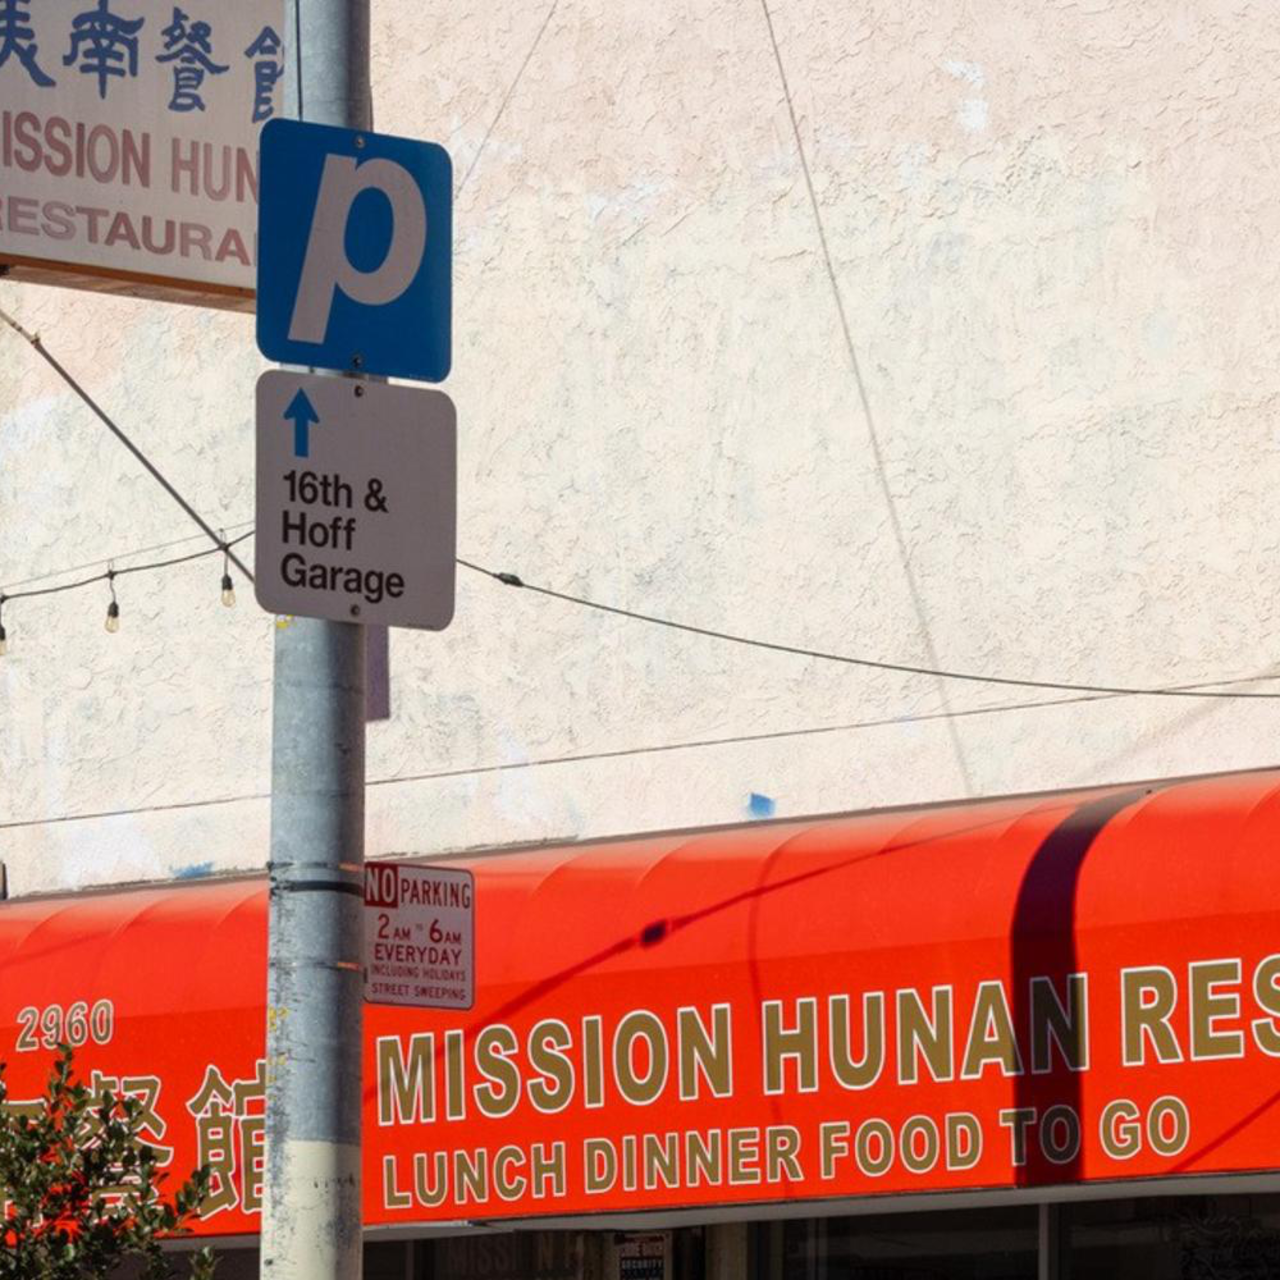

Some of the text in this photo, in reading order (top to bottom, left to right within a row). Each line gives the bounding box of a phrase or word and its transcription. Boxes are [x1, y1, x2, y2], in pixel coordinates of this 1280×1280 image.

[282, 471, 388, 513] 16th &
[281, 511, 356, 551] Hoff
[281, 553, 405, 605] Garage
[366, 866, 470, 909] NO PARKING
[371, 964, 466, 982] INCLUDING HOLIDAYS
[374, 943, 462, 966] EVERYDAY
[371, 982, 466, 1001] STREET SWEEPING
[16, 999, 114, 1051] 2960
[376, 1001, 734, 1127] MISSION
[761, 972, 1090, 1096] HUNAN
[382, 1094, 1191, 1210] LUNCH DINNER FOOD TO GO
